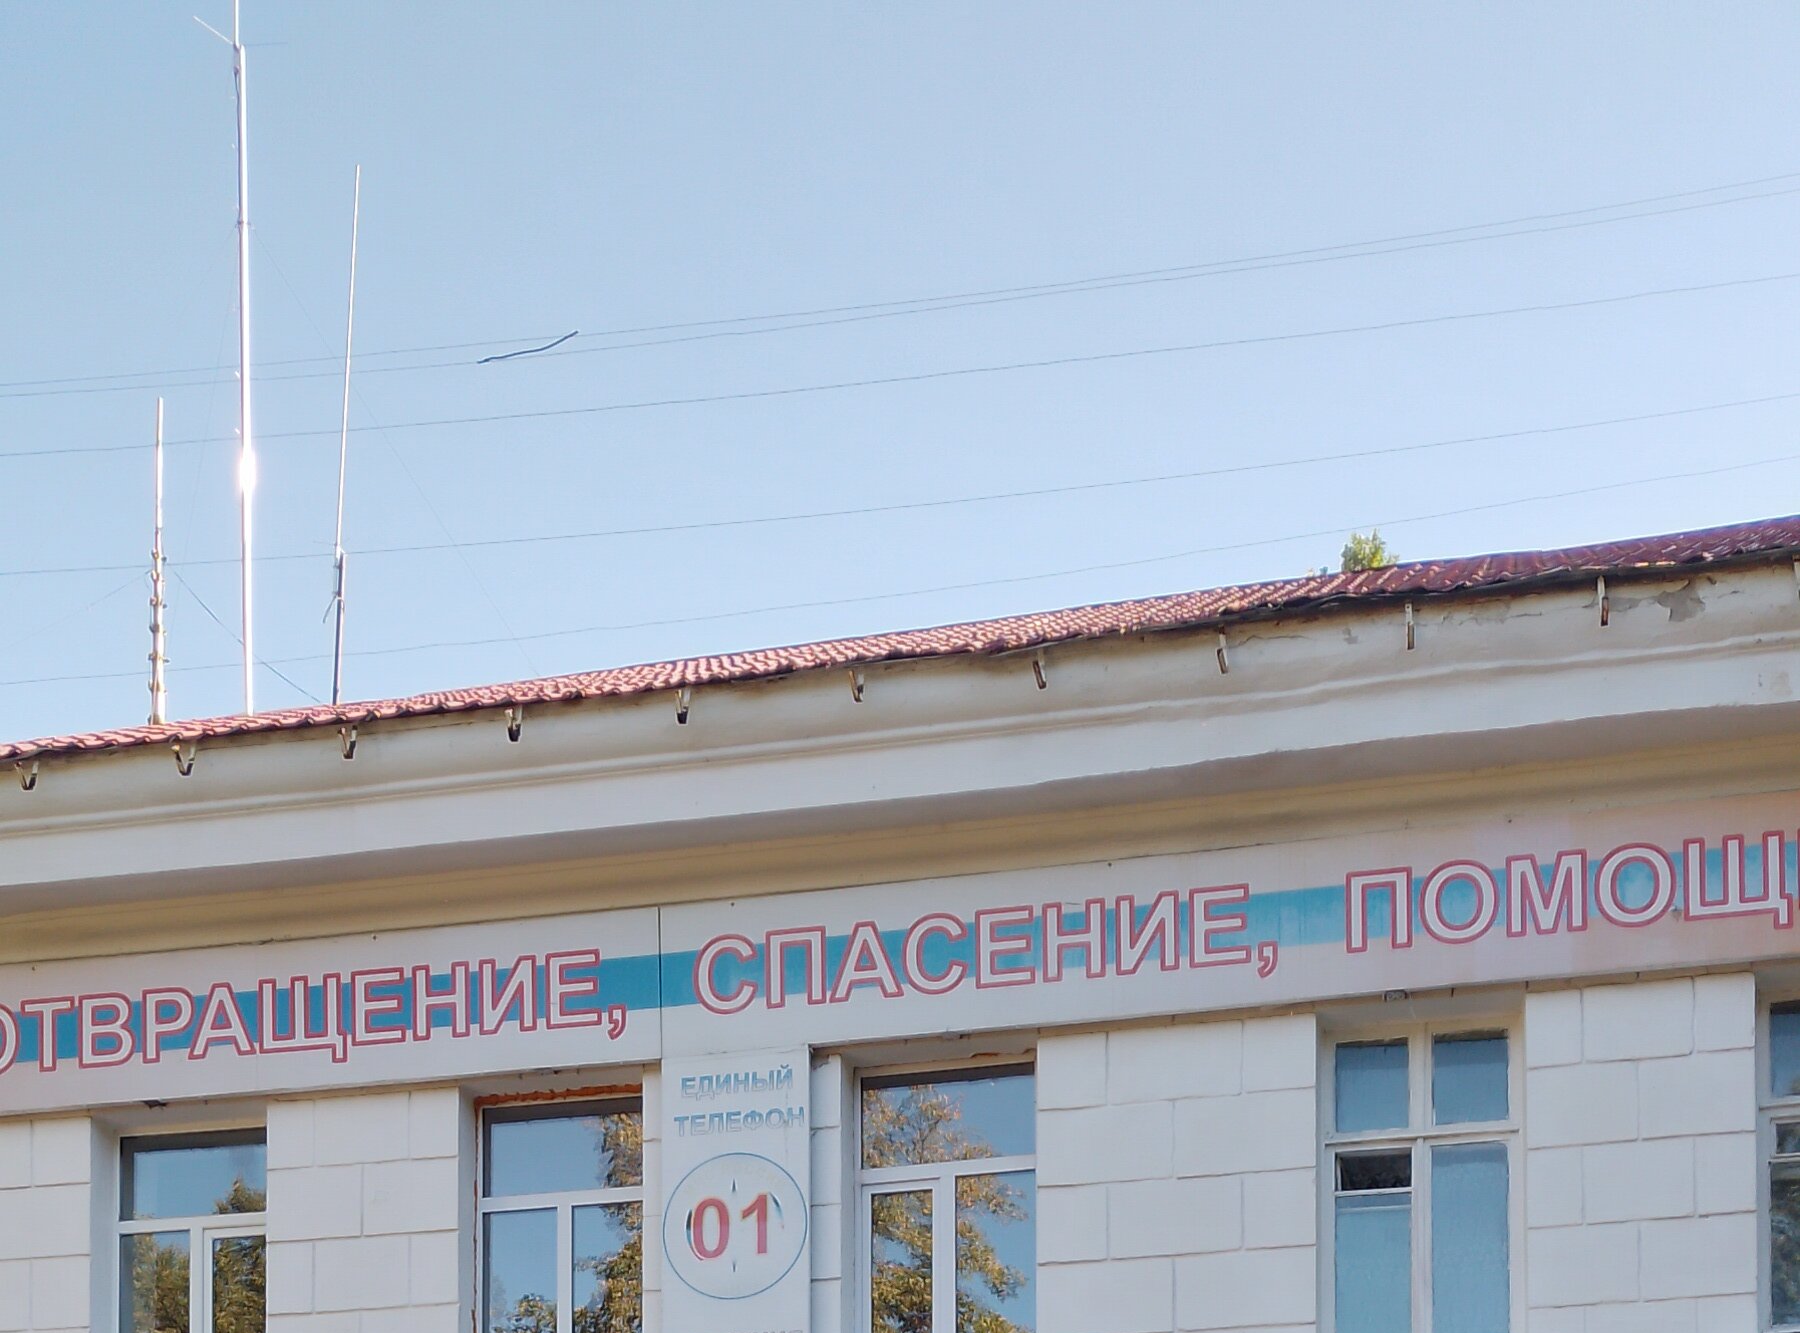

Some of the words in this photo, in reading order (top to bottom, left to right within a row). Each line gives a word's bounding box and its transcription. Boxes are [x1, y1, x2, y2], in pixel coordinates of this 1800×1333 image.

[693, 883, 1279, 1014] СПАСЕНИЕ,
[1345, 829, 1800, 953] ПОМОЩ
[681, 1064, 793, 1101] ЕДИНЫЙ
[674, 1106, 805, 1137] ТЕЛЕФОН
[692, 1193, 767, 1259] 01
